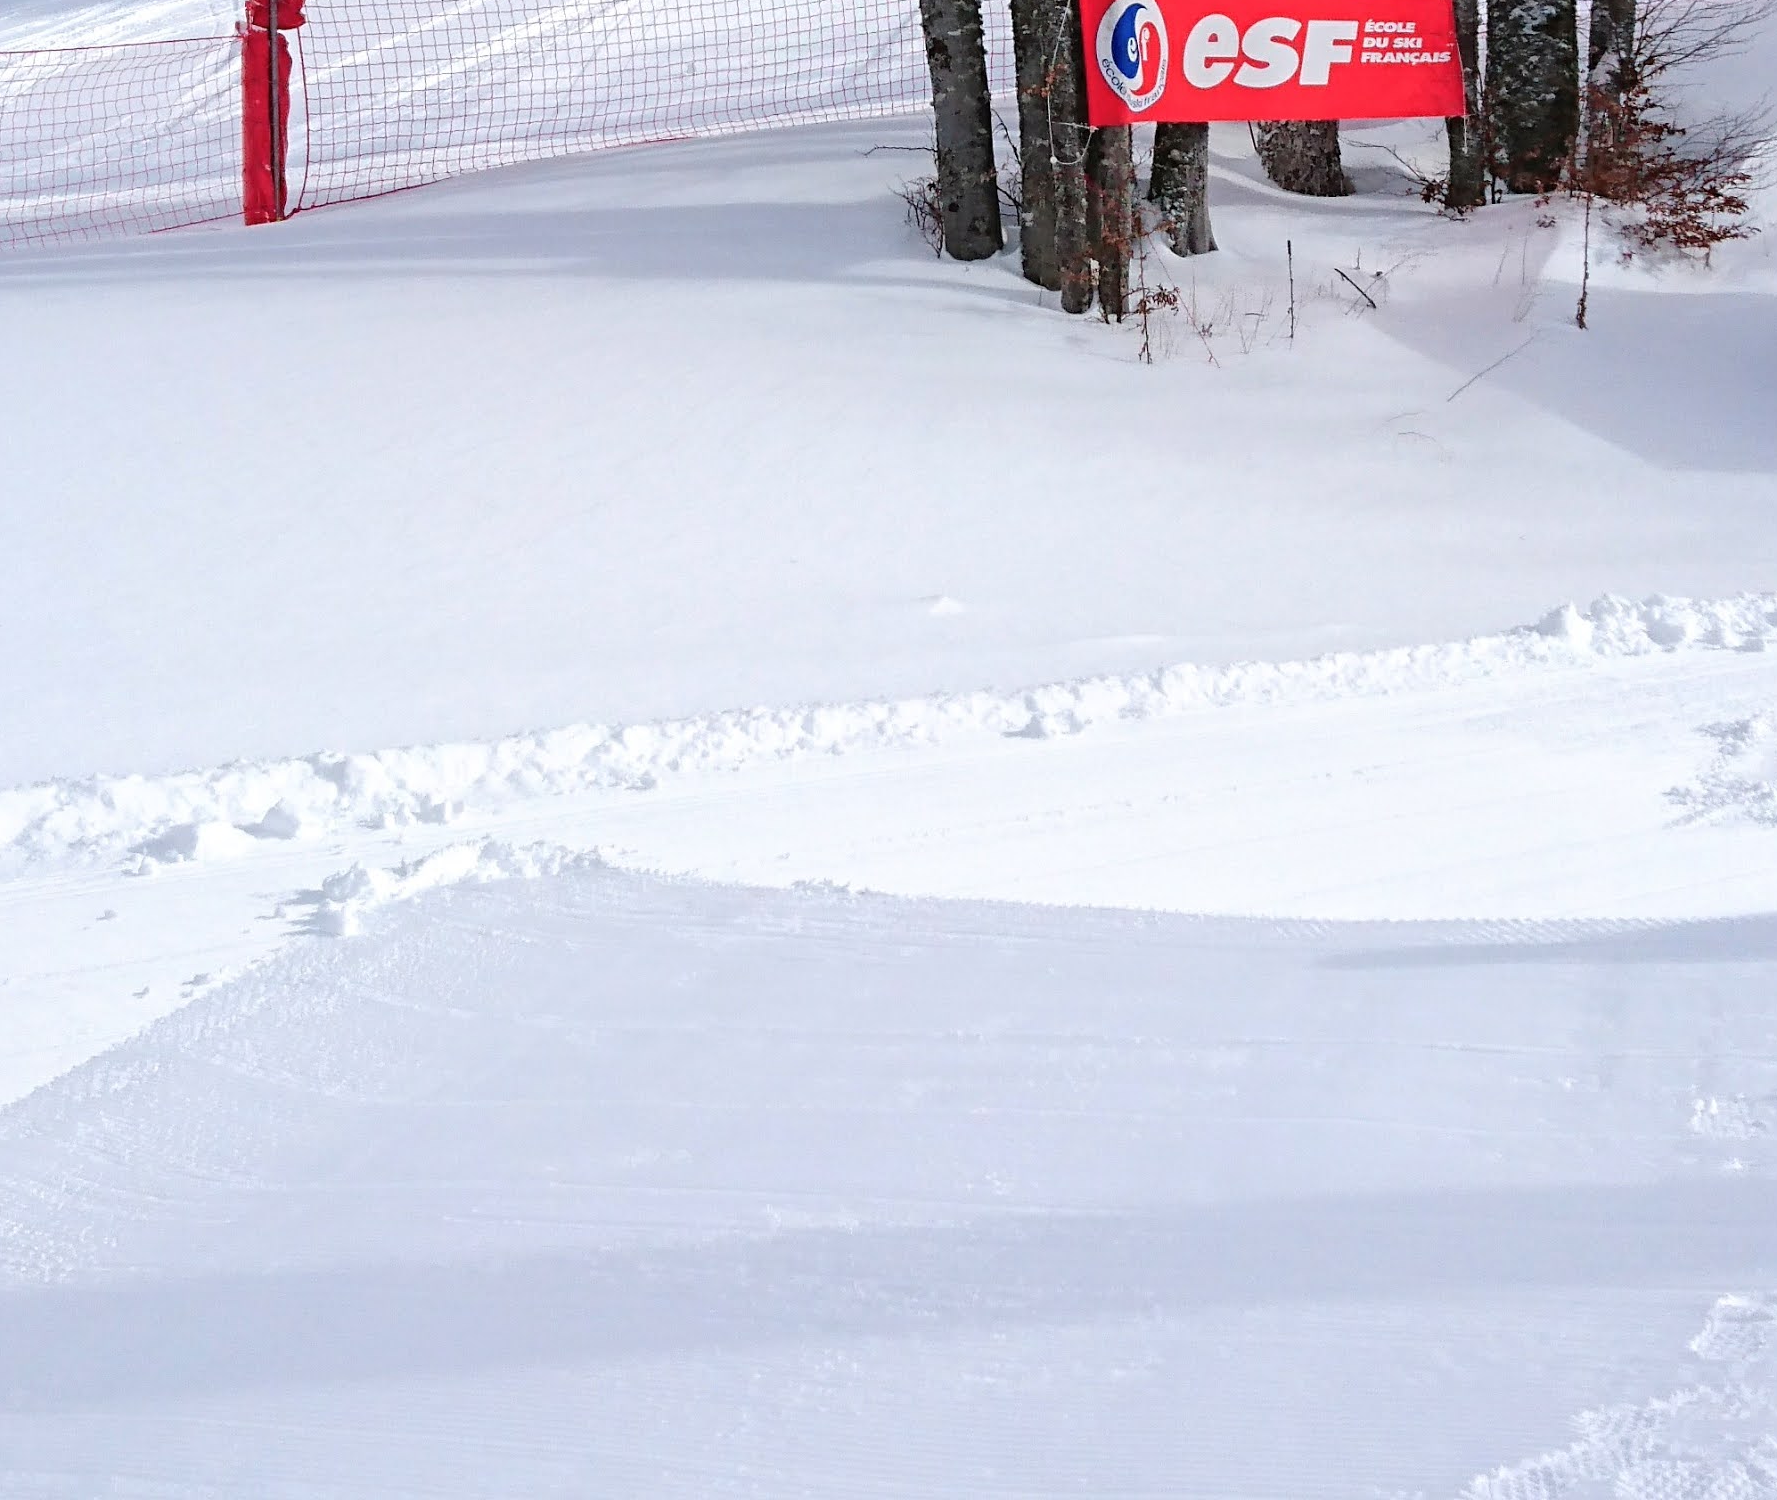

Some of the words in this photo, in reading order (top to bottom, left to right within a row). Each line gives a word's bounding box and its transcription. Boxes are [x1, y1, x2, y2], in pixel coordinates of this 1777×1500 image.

[1364, 19, 1416, 33] ÉCOLE
[1363, 37, 1389, 48] DU
[1392, 37, 1423, 48] SKI
[1361, 51, 1451, 66] FRANÇAIS
[1102, 58, 1127, 95] école
